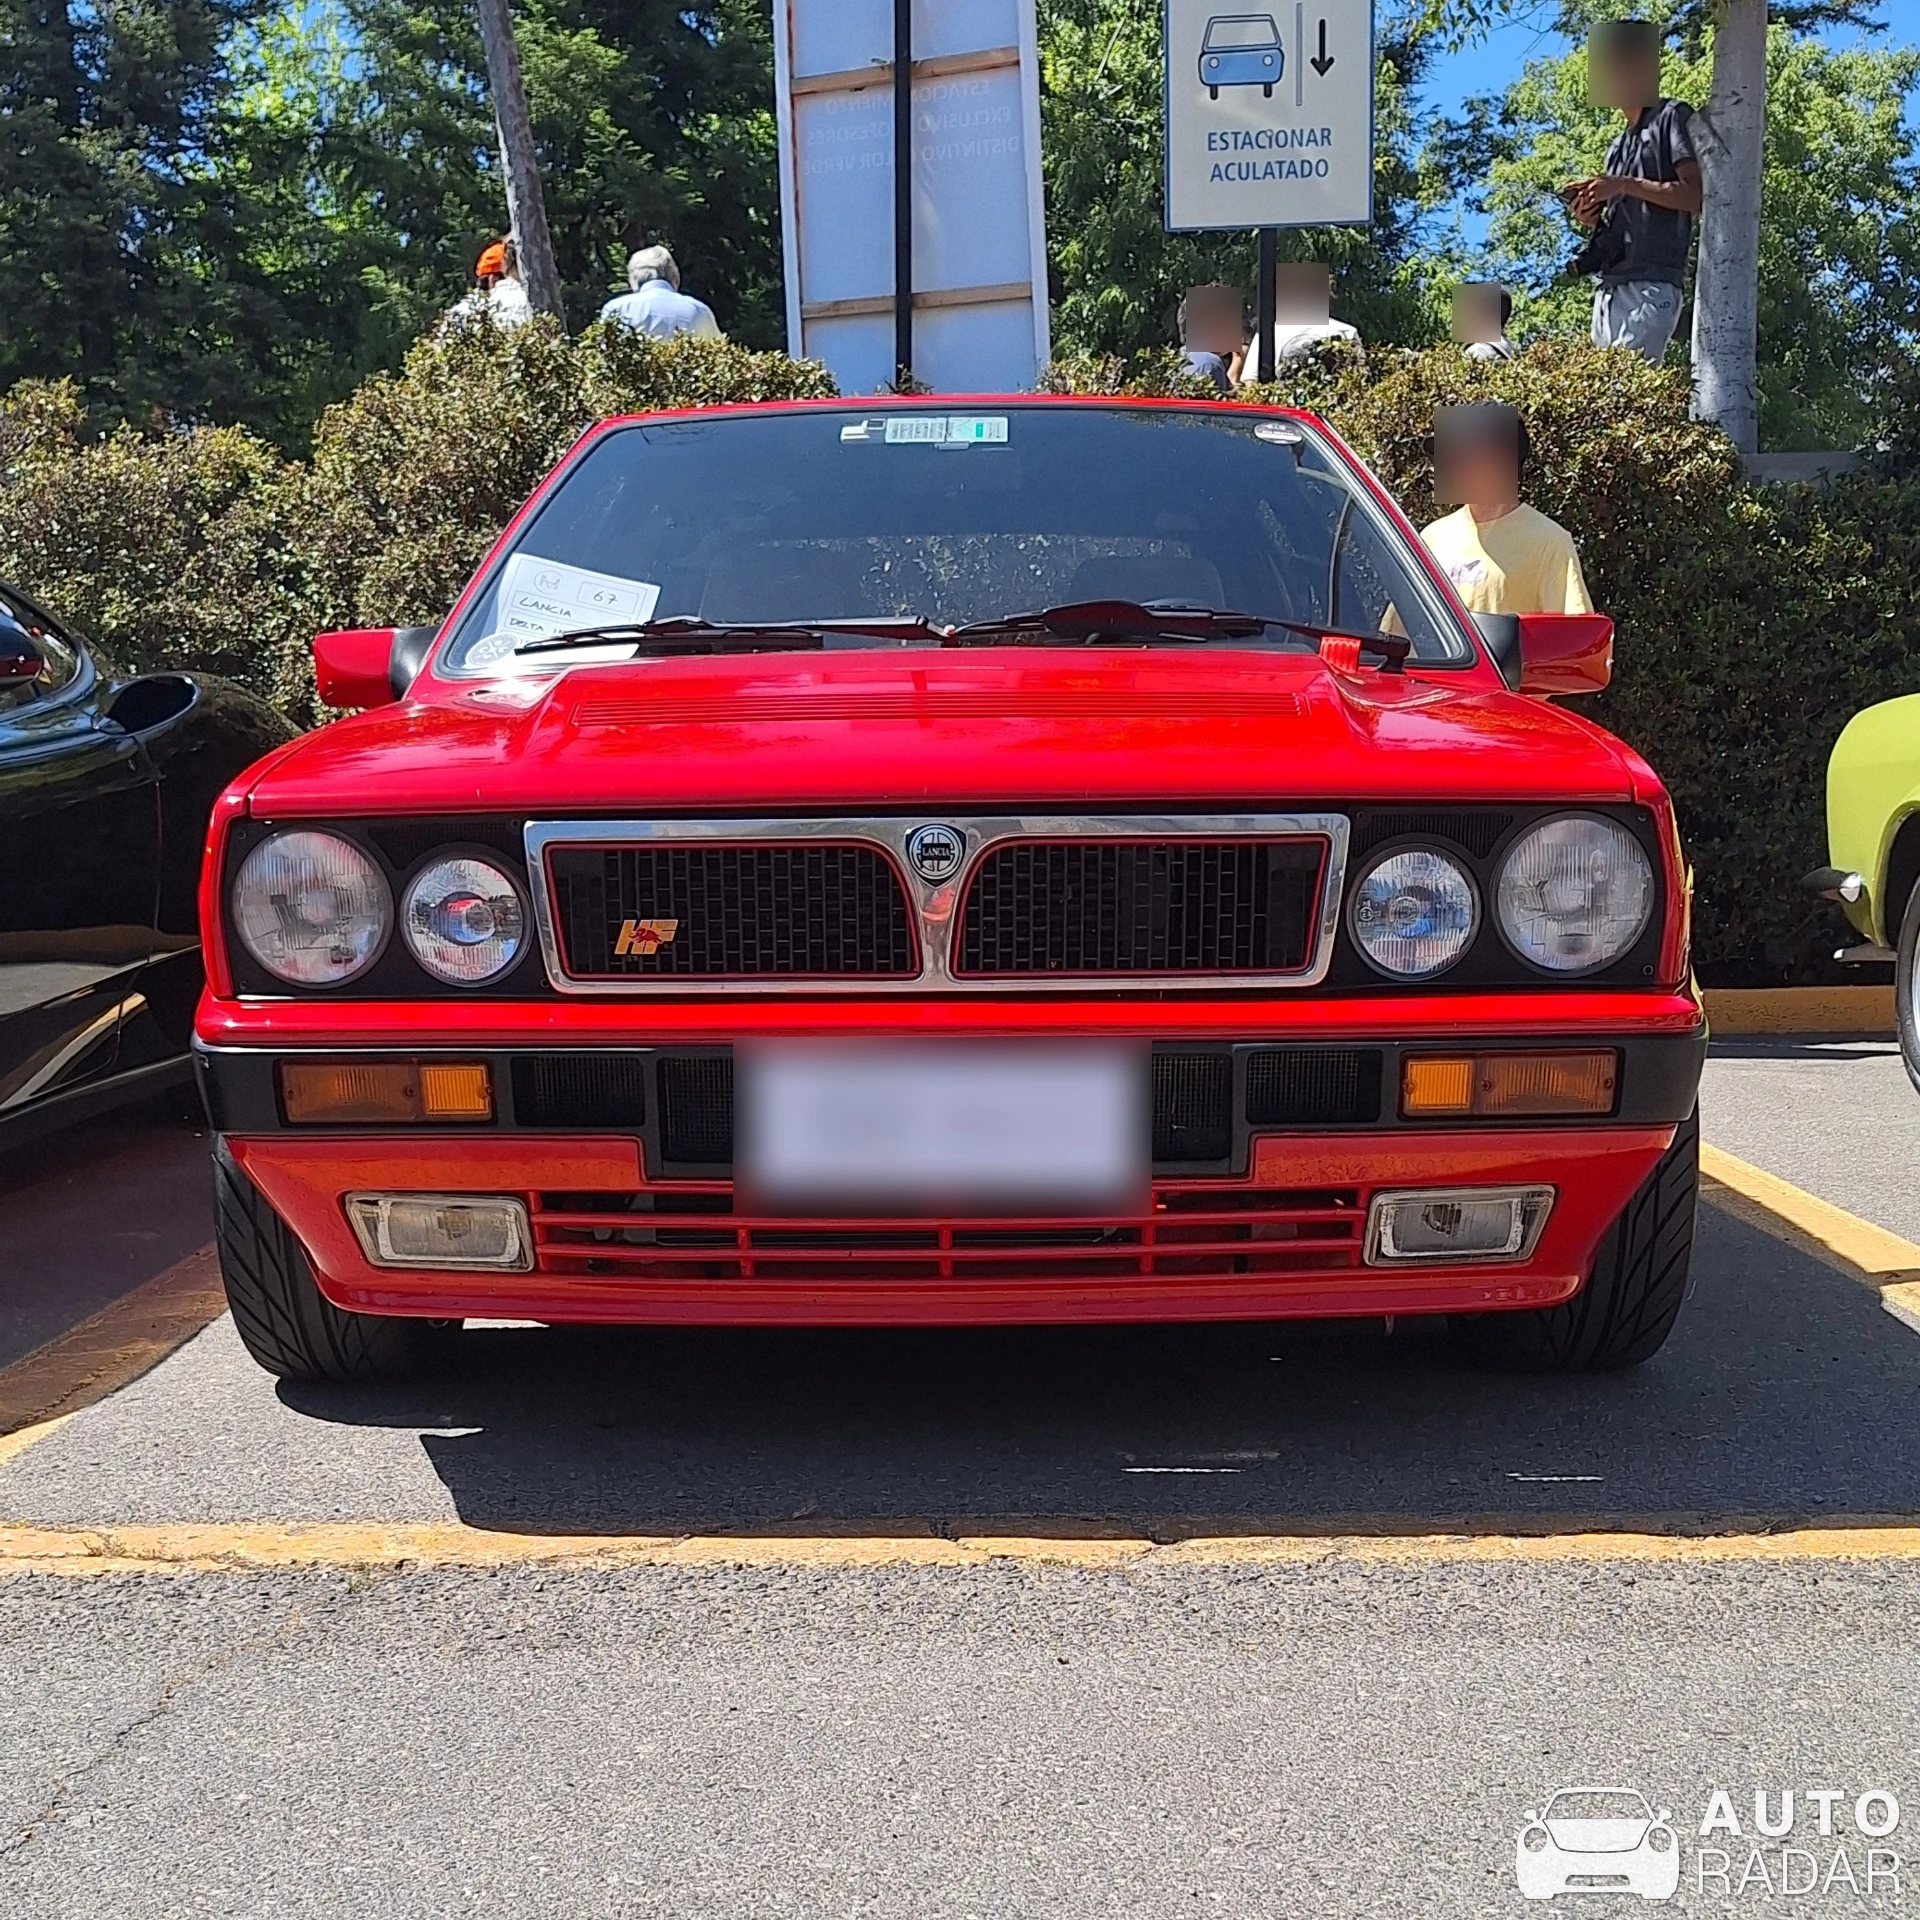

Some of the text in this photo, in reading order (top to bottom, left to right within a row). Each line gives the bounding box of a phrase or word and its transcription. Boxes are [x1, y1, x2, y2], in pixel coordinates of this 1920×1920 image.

[1207, 127, 1332, 151] ESTACIONAR
[1210, 158, 1329, 182] ACULATADO
[519, 596, 572, 618] LANCIA
[593, 590, 618, 605] 67
[509, 618, 544, 632] DELTA
[922, 846, 951, 857] LANCIA
[614, 919, 679, 955] HF
